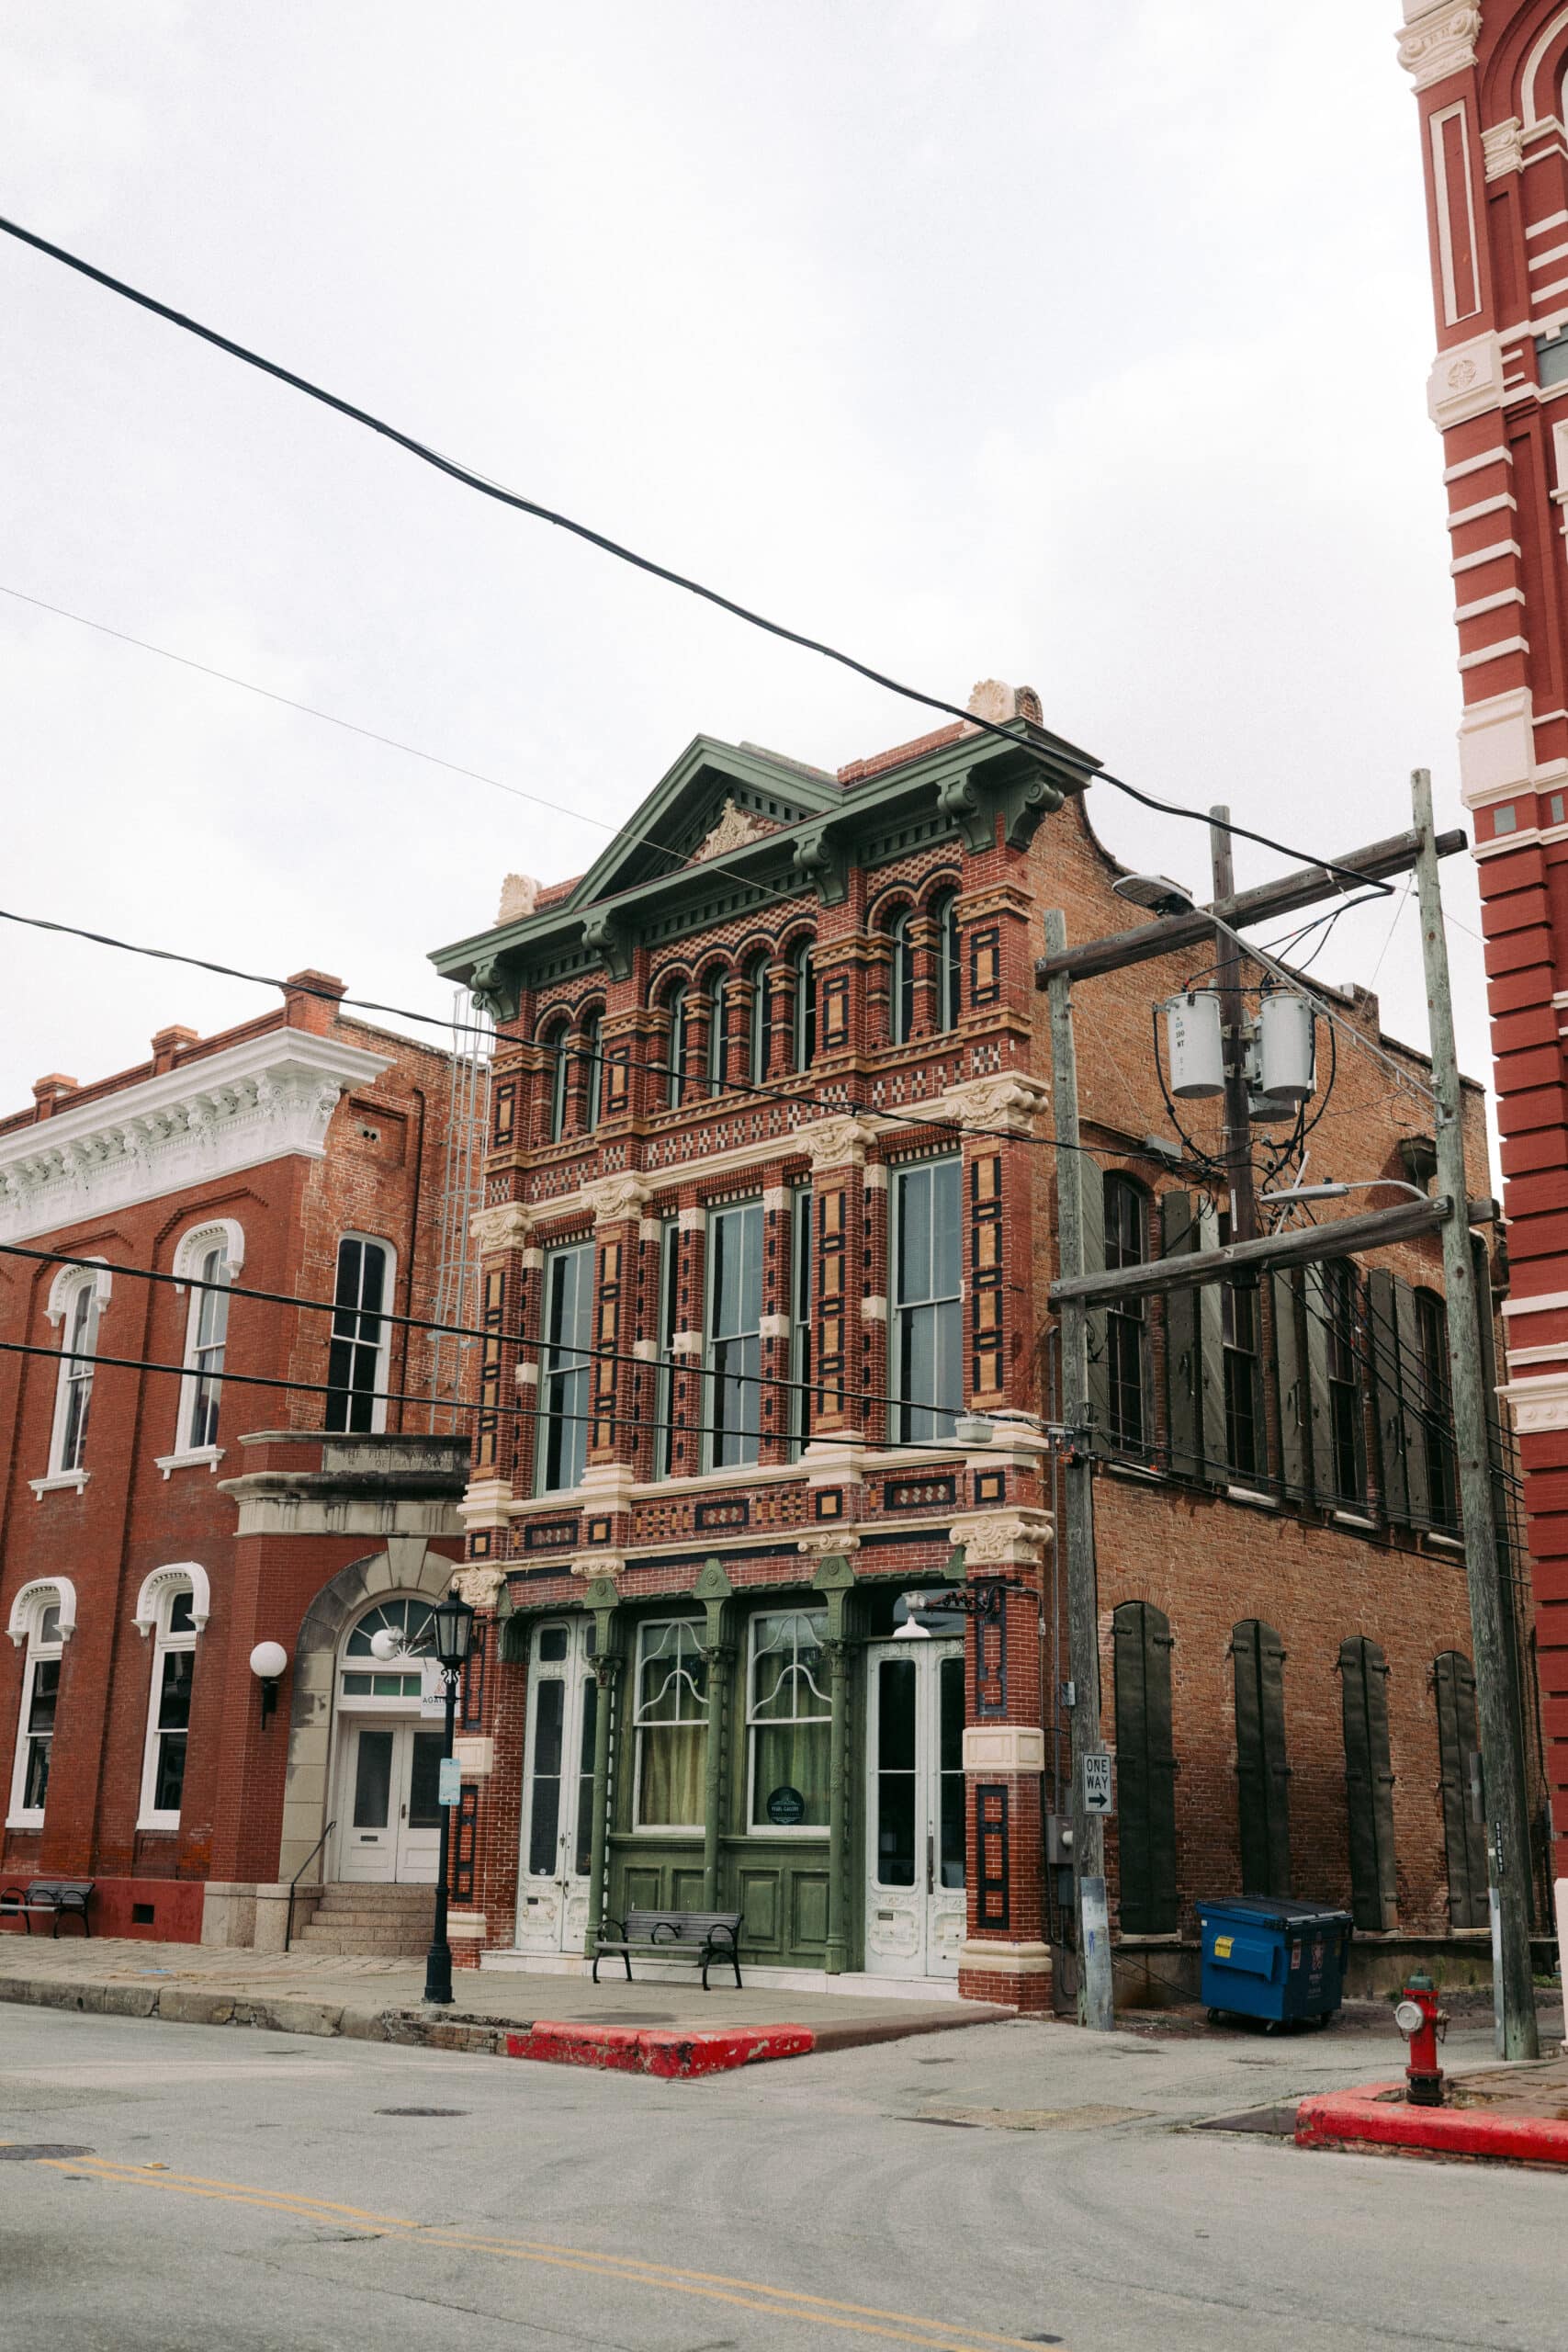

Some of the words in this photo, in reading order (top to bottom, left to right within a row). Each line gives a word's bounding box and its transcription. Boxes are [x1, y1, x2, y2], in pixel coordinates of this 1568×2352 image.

[343, 1449, 363, 1459] THE
[369, 1449, 397, 1459] FIRST
[375, 1460, 388, 1468] OF
[394, 1460, 453, 1469] GALVESTON
[1087, 1758, 1107, 1772] ONE
[1087, 1775, 1108, 1789] WAY
